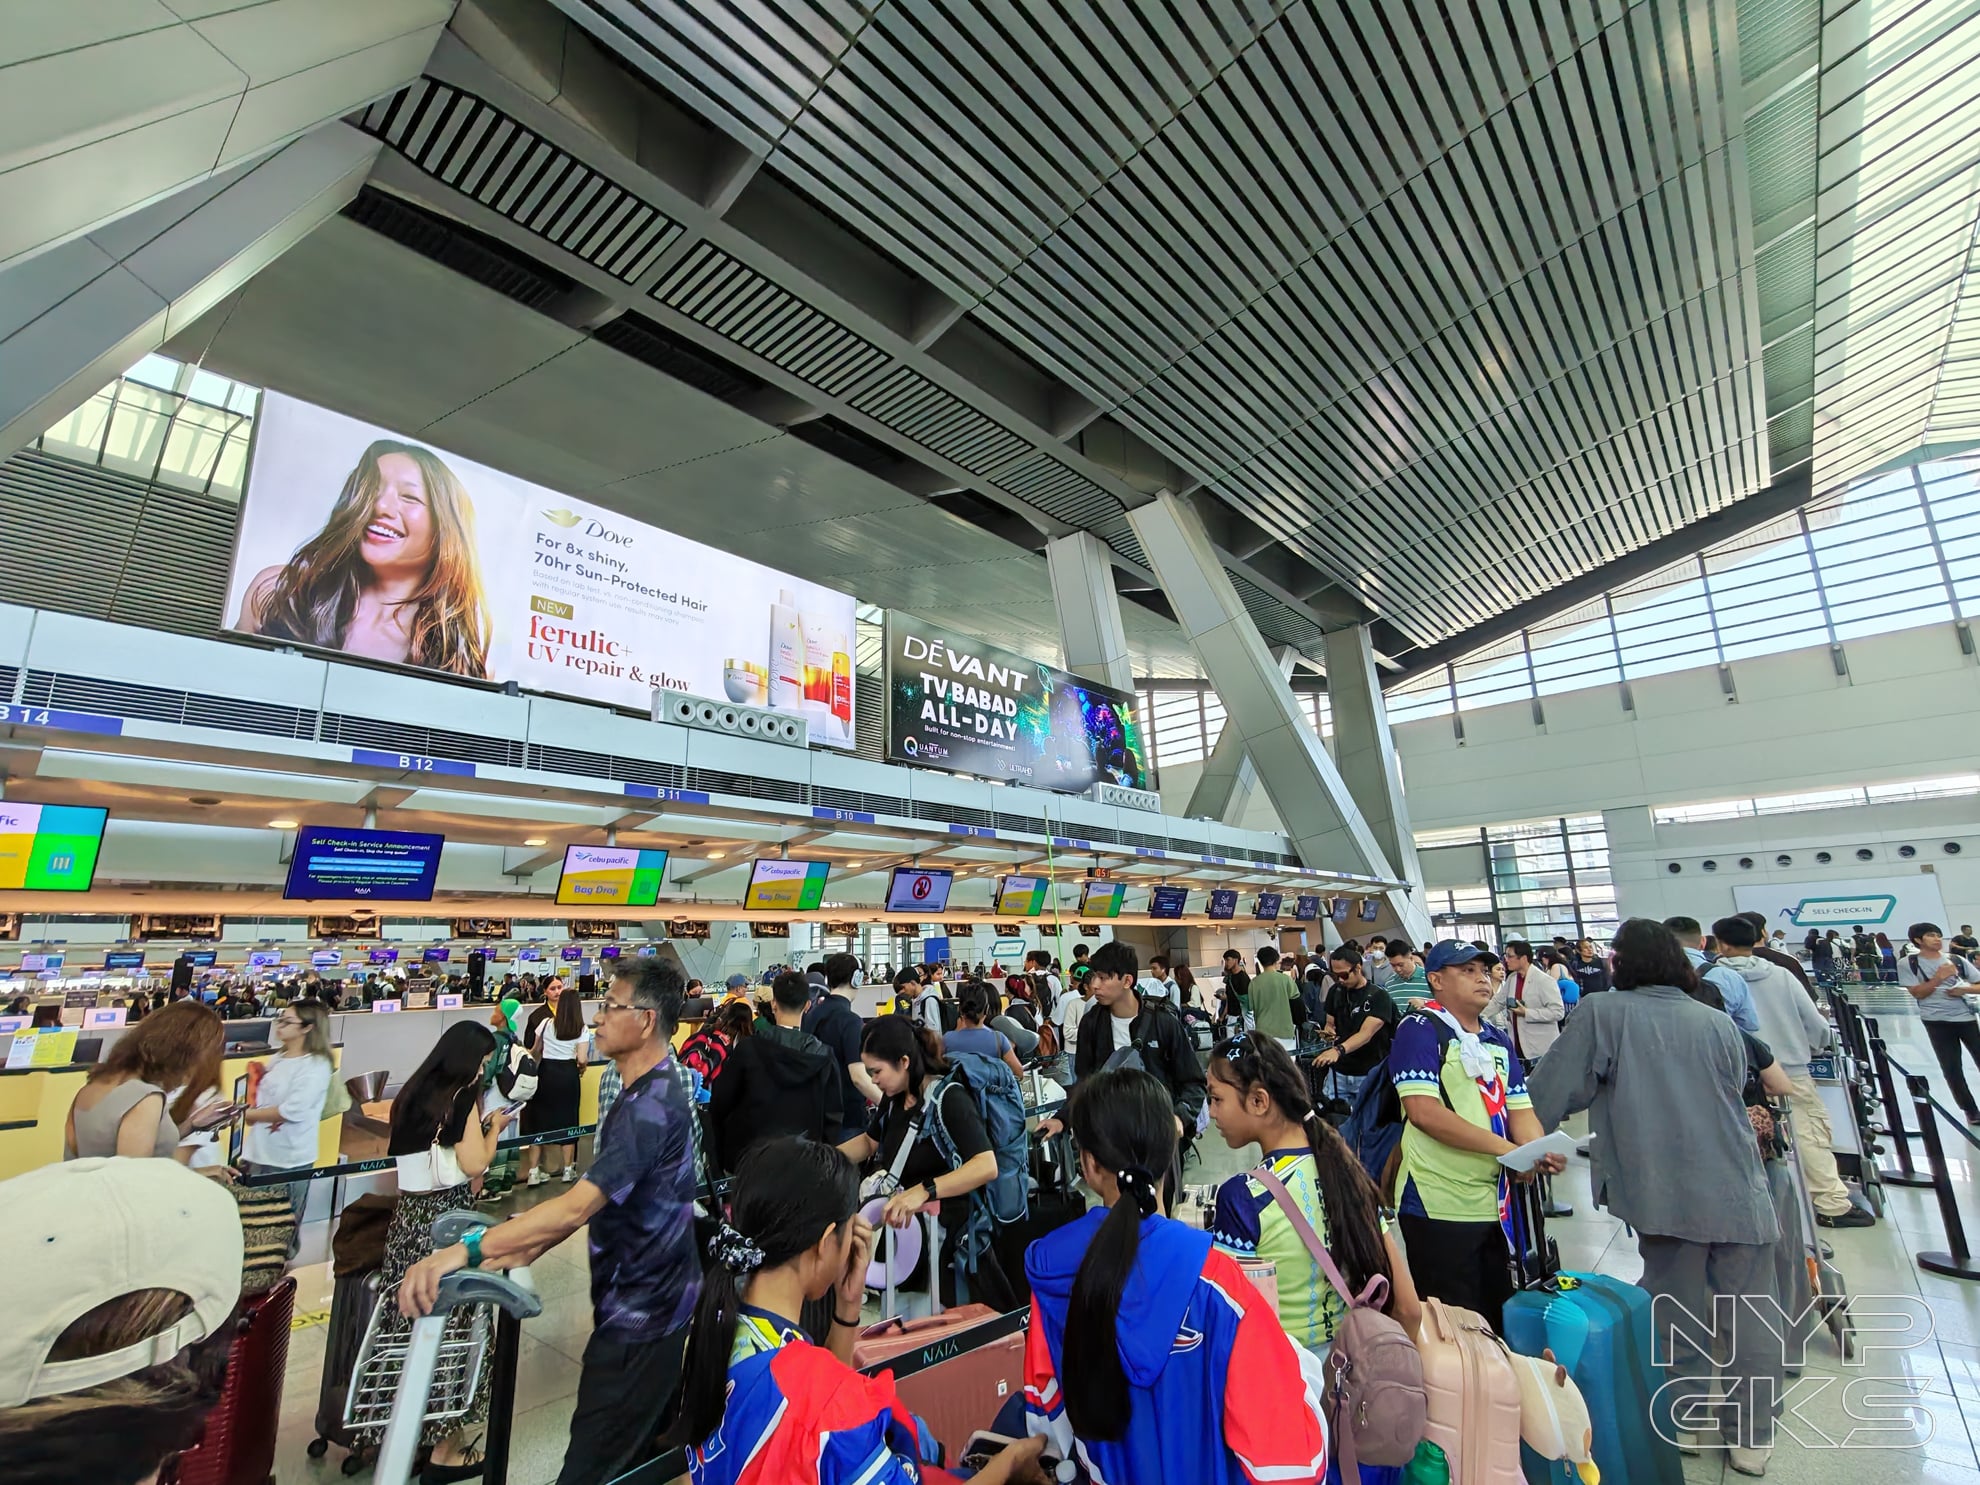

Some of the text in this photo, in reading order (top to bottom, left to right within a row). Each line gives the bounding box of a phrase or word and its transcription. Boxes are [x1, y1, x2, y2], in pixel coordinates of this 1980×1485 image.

[585, 518, 634, 549] Dove
[536, 532, 629, 573] For 8x shiny,
[533, 568, 559, 583] Based
[572, 580, 585, 590] lab
[534, 551, 708, 612] 70hr Sun-Protected Hair
[551, 585, 581, 598] regular
[536, 599, 568, 615] NEW
[529, 615, 632, 657] ferulic+
[528, 642, 691, 692] UV repair & glow
[903, 635, 1029, 692] DÉVANT
[919, 671, 1018, 717] TV BABAD
[20, 709, 50, 725] 14
[920, 699, 1018, 741] ALL-DAY
[924, 724, 939, 734] Built
[940, 728, 949, 736] for
[399, 755, 433, 771] B 12
[657, 788, 680, 800] B 11
[836, 810, 854, 821] B 10
[327, 839, 357, 847] Check-in
[359, 840, 383, 848] Service
[384, 842, 431, 851] Announcement
[606, 856, 629, 864] pacific
[574, 885, 619, 896] Bag Drop
[1832, 906, 1873, 915] CHECK-IN
[567, 1127, 587, 1137] NAIA
[360, 1160, 387, 1171] NAIA
[923, 1338, 959, 1365] NAIA
